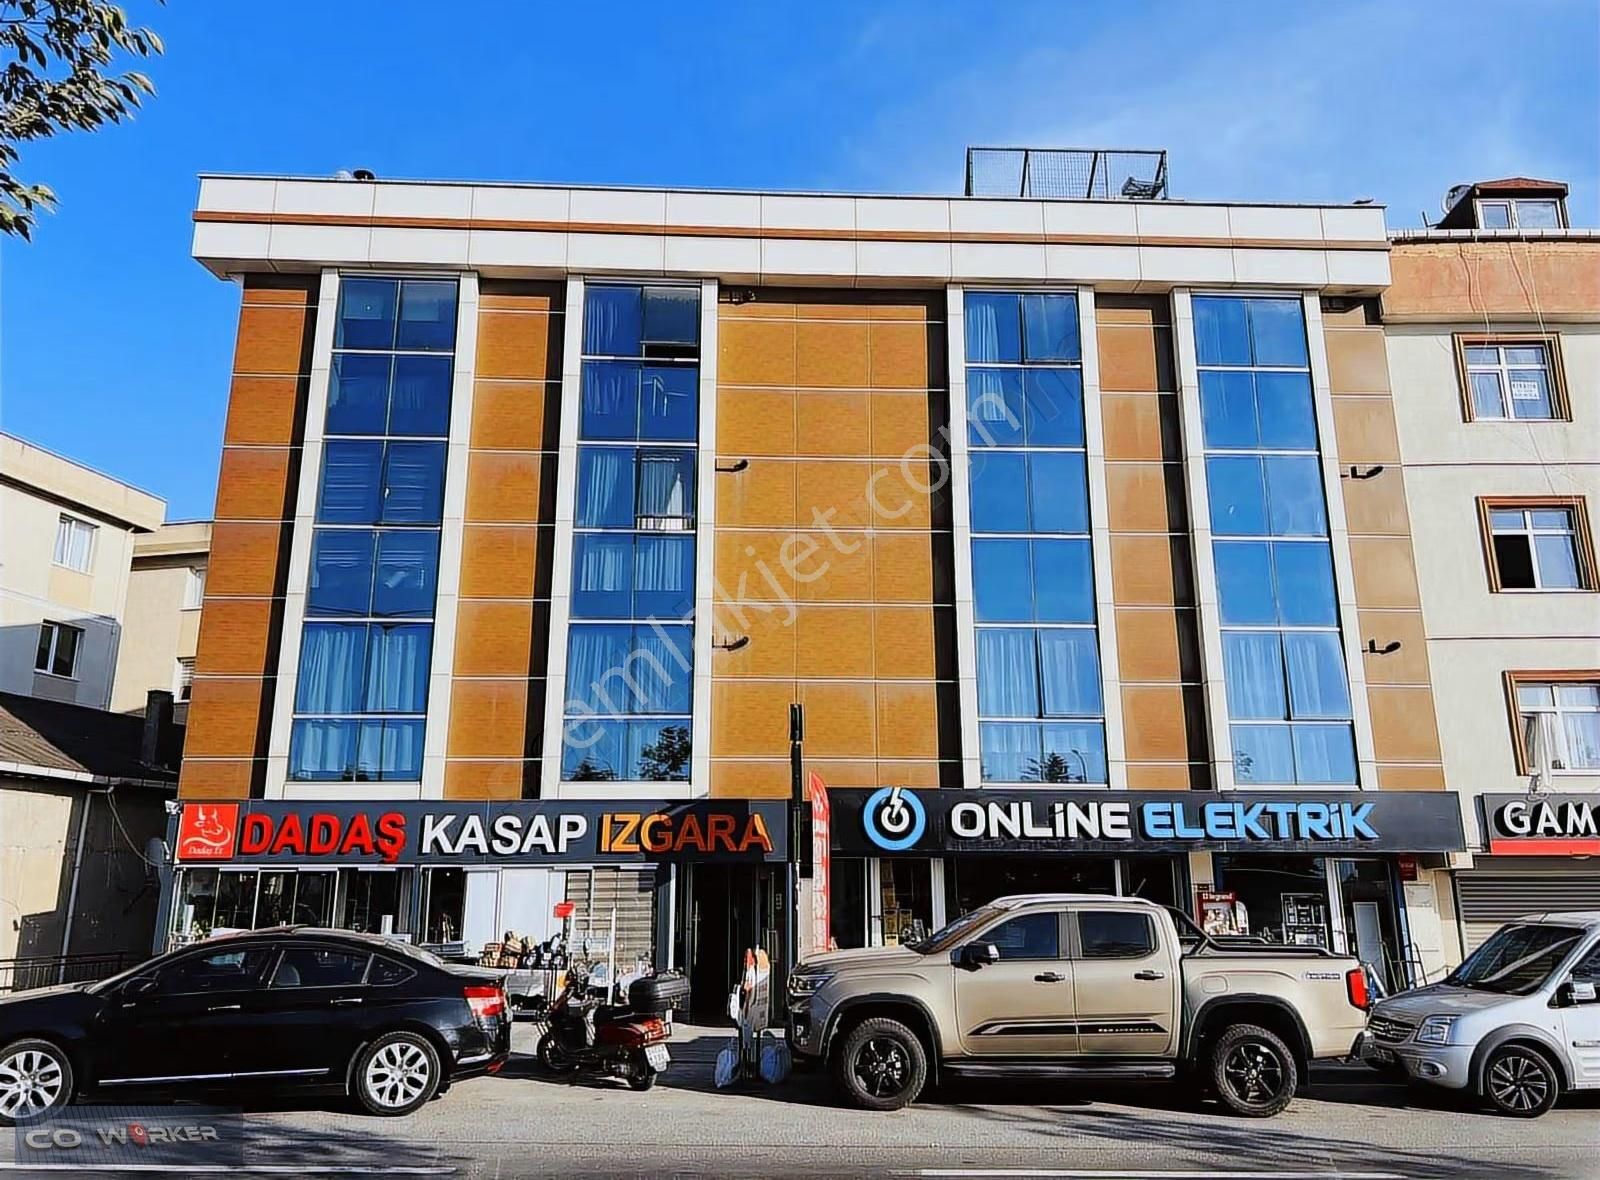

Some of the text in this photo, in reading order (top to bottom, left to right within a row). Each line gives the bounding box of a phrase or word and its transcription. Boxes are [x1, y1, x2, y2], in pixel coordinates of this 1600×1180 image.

[241, 812, 774, 862] DADAŞ KASAP IZGARA
[1503, 801, 1598, 834] GAM
